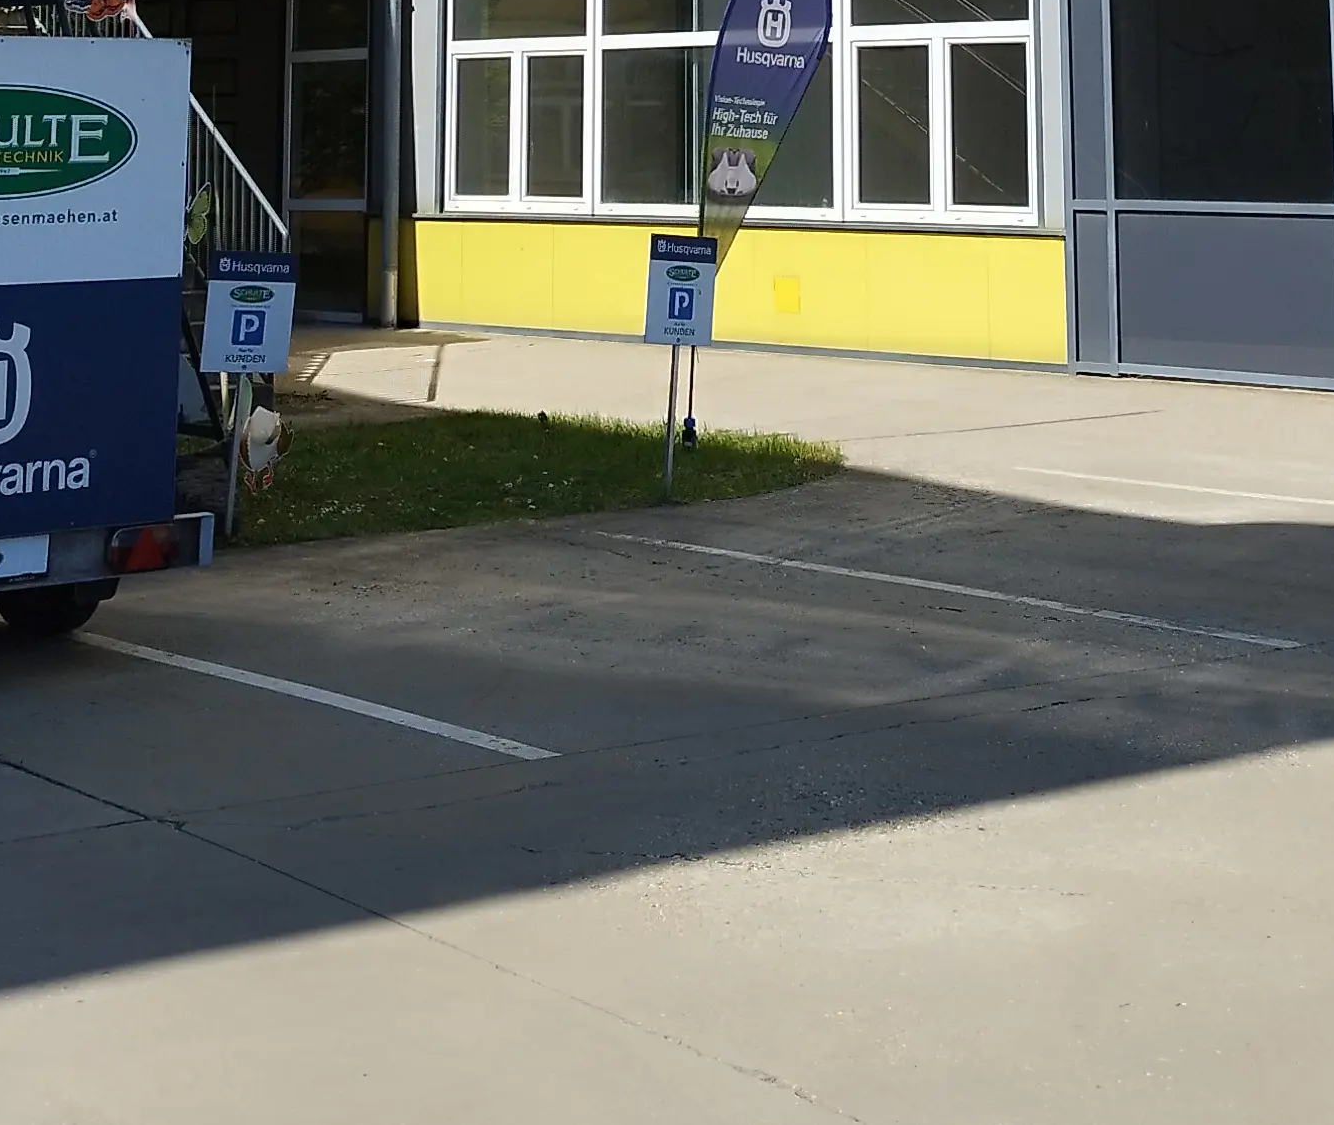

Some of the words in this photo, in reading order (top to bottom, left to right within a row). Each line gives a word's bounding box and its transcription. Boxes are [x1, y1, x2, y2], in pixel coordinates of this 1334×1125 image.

[736, 46, 805, 69] Husqvarna
[712, 106, 762, 124] High-Tech
[763, 111, 779, 125] für
[711, 122, 727, 136] Ihr
[726, 123, 769, 140] Zuhause
[667, 242, 712, 256] Husqvarna
[232, 260, 290, 274] Husqvarna
